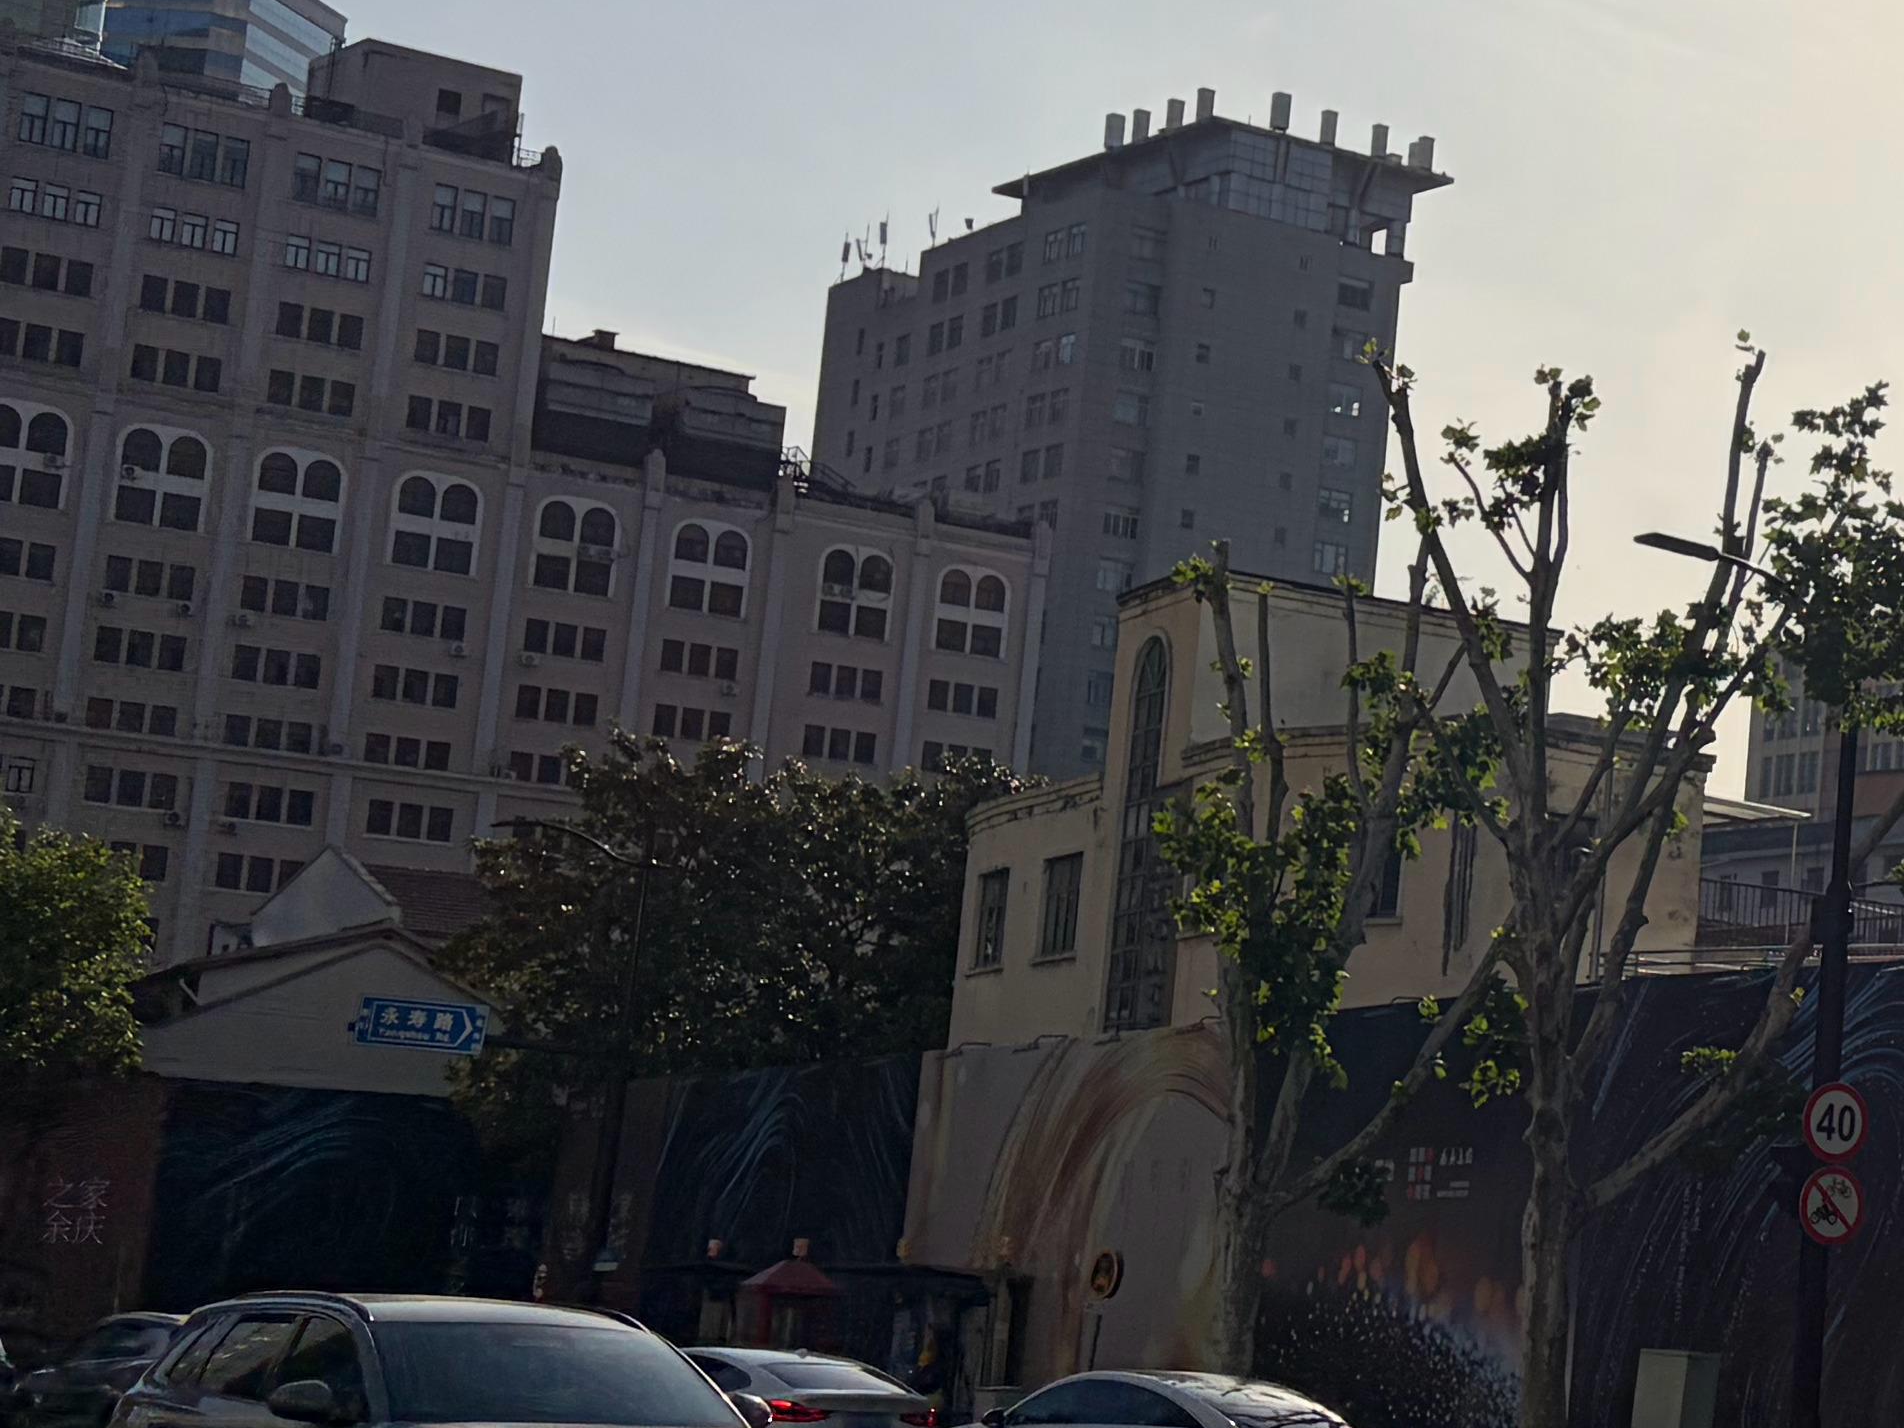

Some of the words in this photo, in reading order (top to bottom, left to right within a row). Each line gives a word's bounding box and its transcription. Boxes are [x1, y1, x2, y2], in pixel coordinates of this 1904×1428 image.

[1816, 1103, 1855, 1141] 40
[43, 1175, 111, 1209] 之家
[40, 1209, 106, 1245] 余庆
